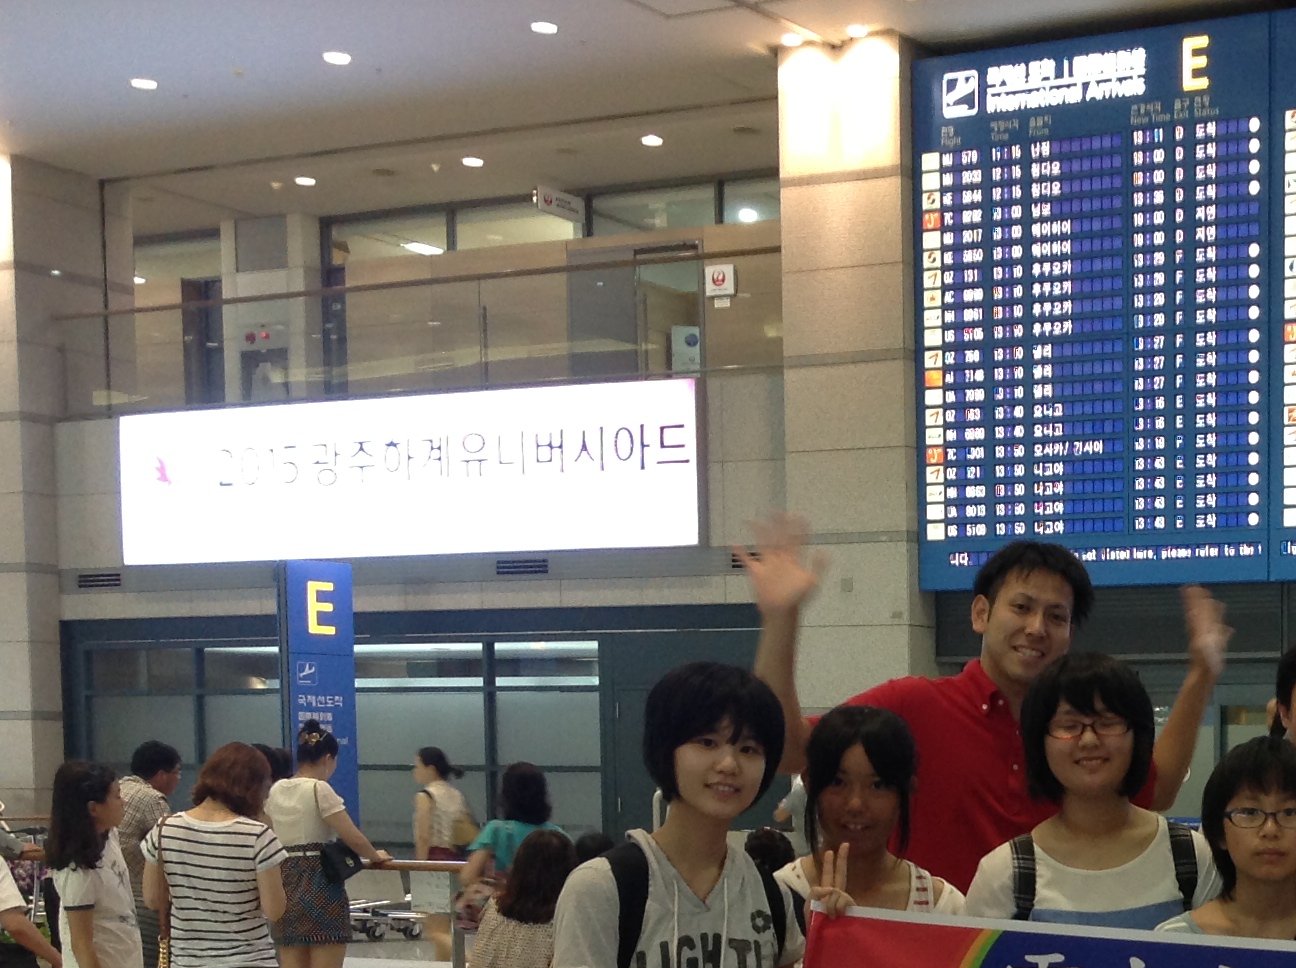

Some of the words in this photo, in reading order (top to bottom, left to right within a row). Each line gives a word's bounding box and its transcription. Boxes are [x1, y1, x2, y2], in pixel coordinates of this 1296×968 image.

[1182, 35, 1210, 92] E
[941, 136, 961, 147] Flight
[307, 580, 336, 635] E
